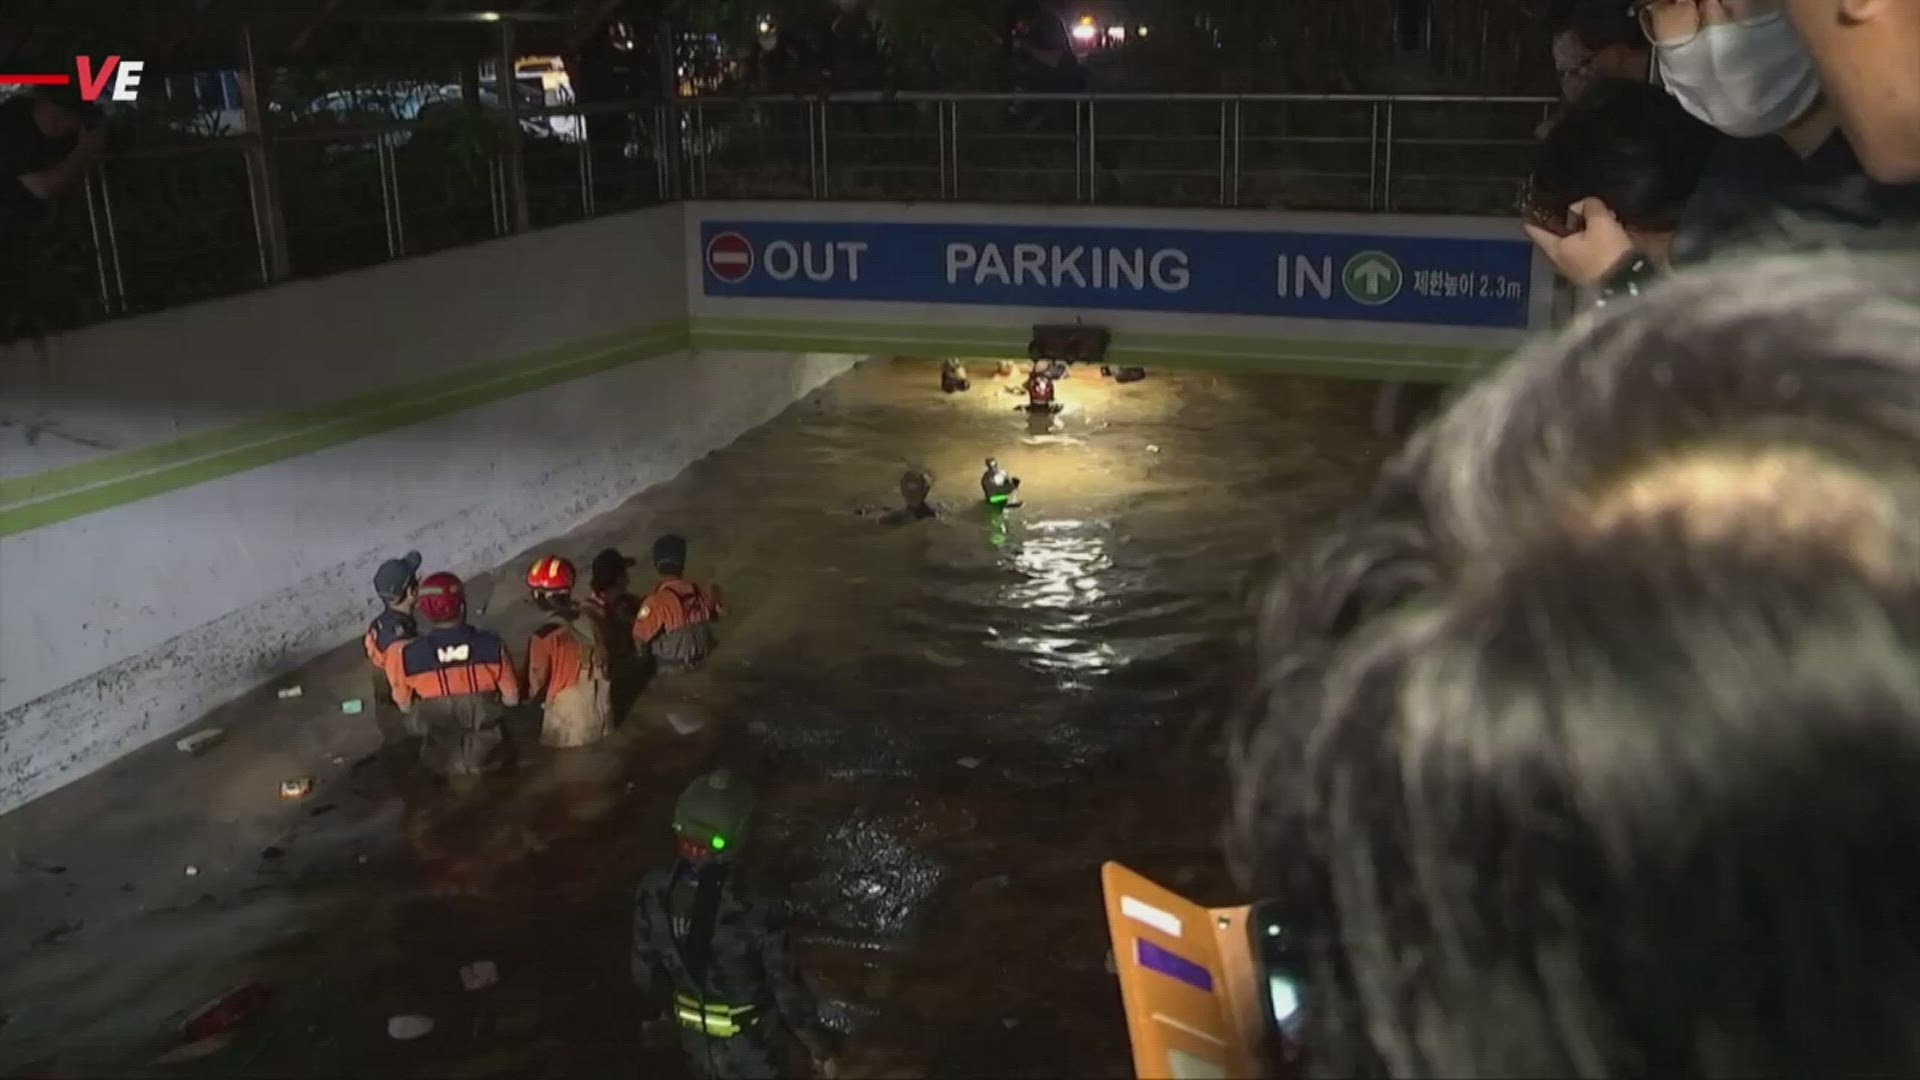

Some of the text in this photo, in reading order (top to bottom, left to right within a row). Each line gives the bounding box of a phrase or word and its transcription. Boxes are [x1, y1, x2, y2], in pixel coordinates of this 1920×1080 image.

[763, 240, 1332, 299] OUT PARKING IN
[1414, 269, 1521, 300] 제한높이 2.3m
